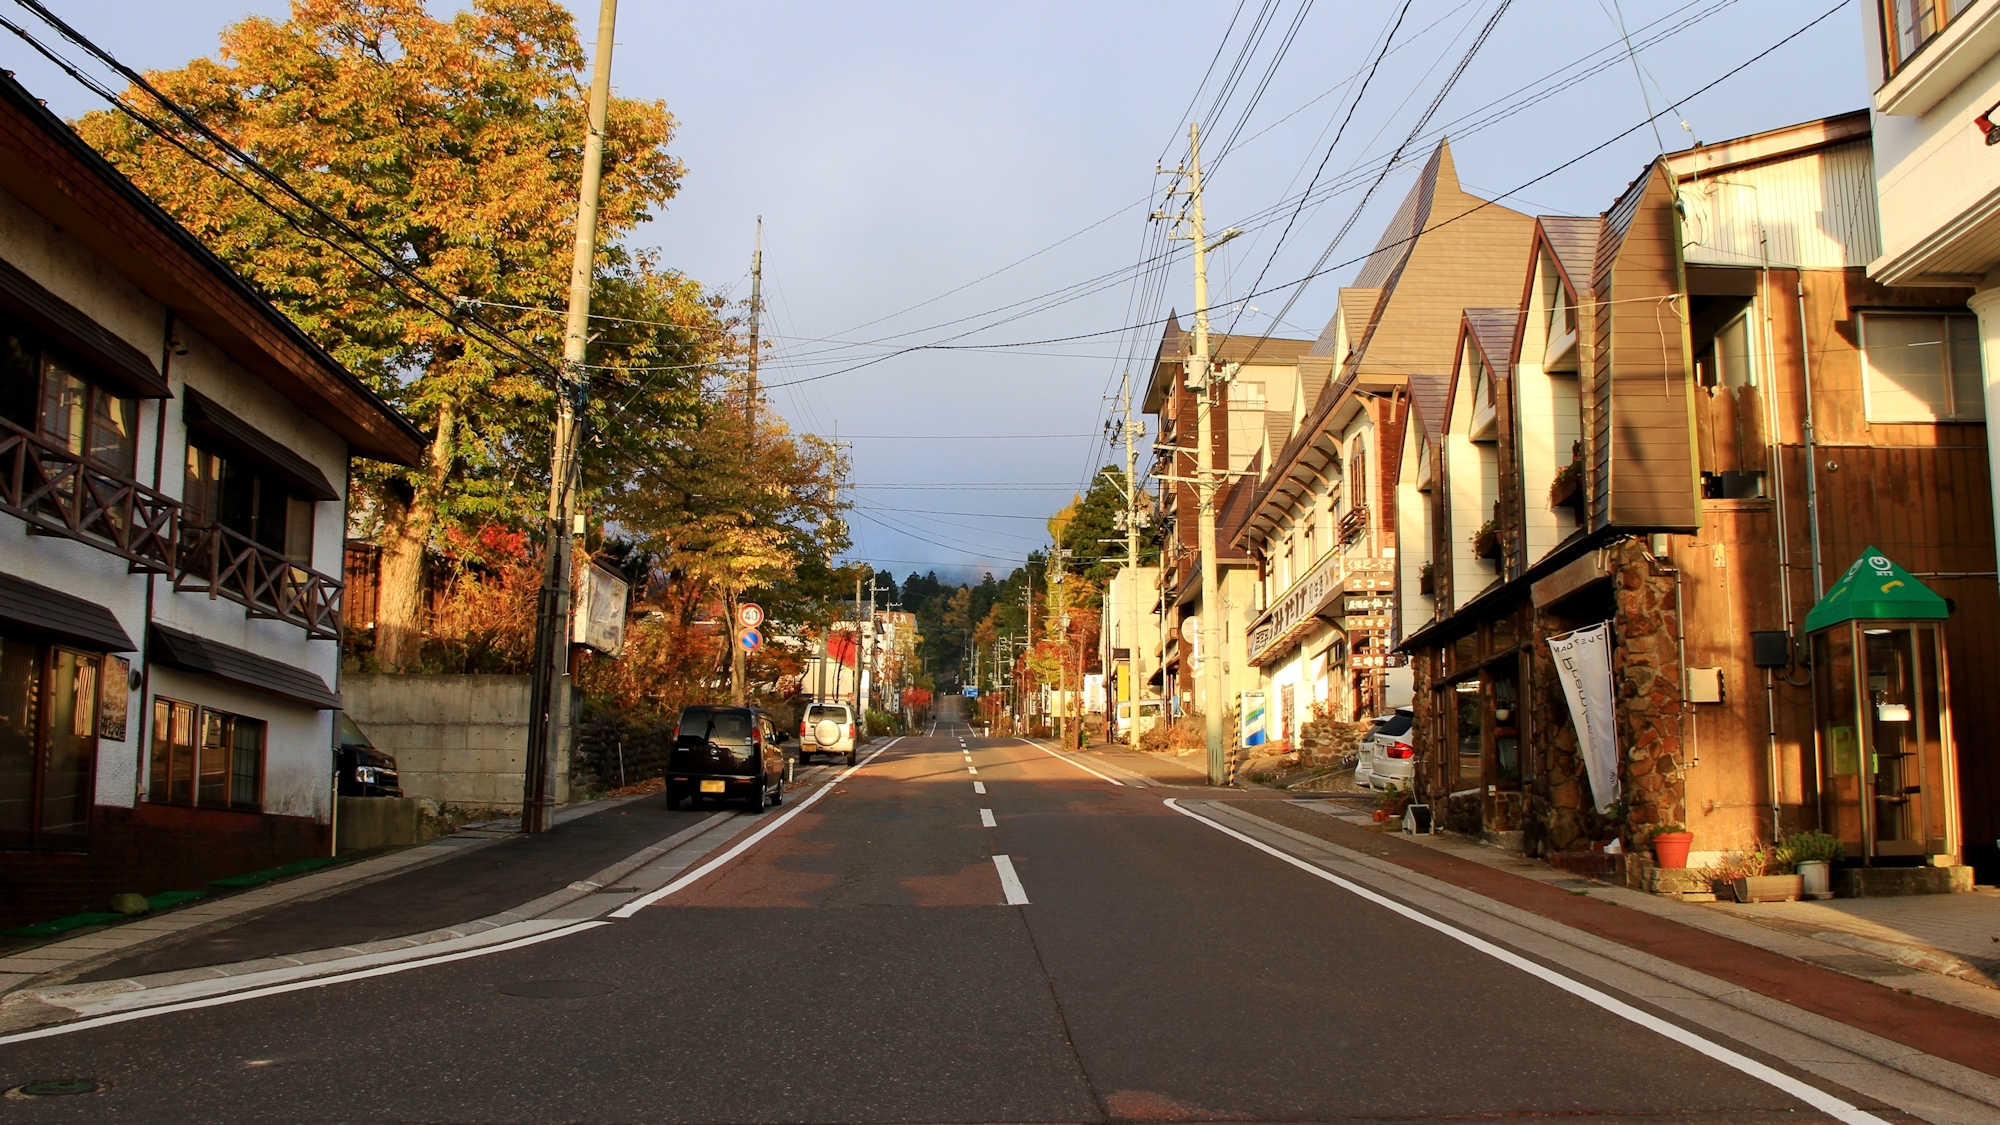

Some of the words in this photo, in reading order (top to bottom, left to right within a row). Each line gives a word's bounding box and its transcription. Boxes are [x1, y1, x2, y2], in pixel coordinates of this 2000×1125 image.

[1352, 579, 1391, 589] エコー
[744, 609, 758, 621] 40
